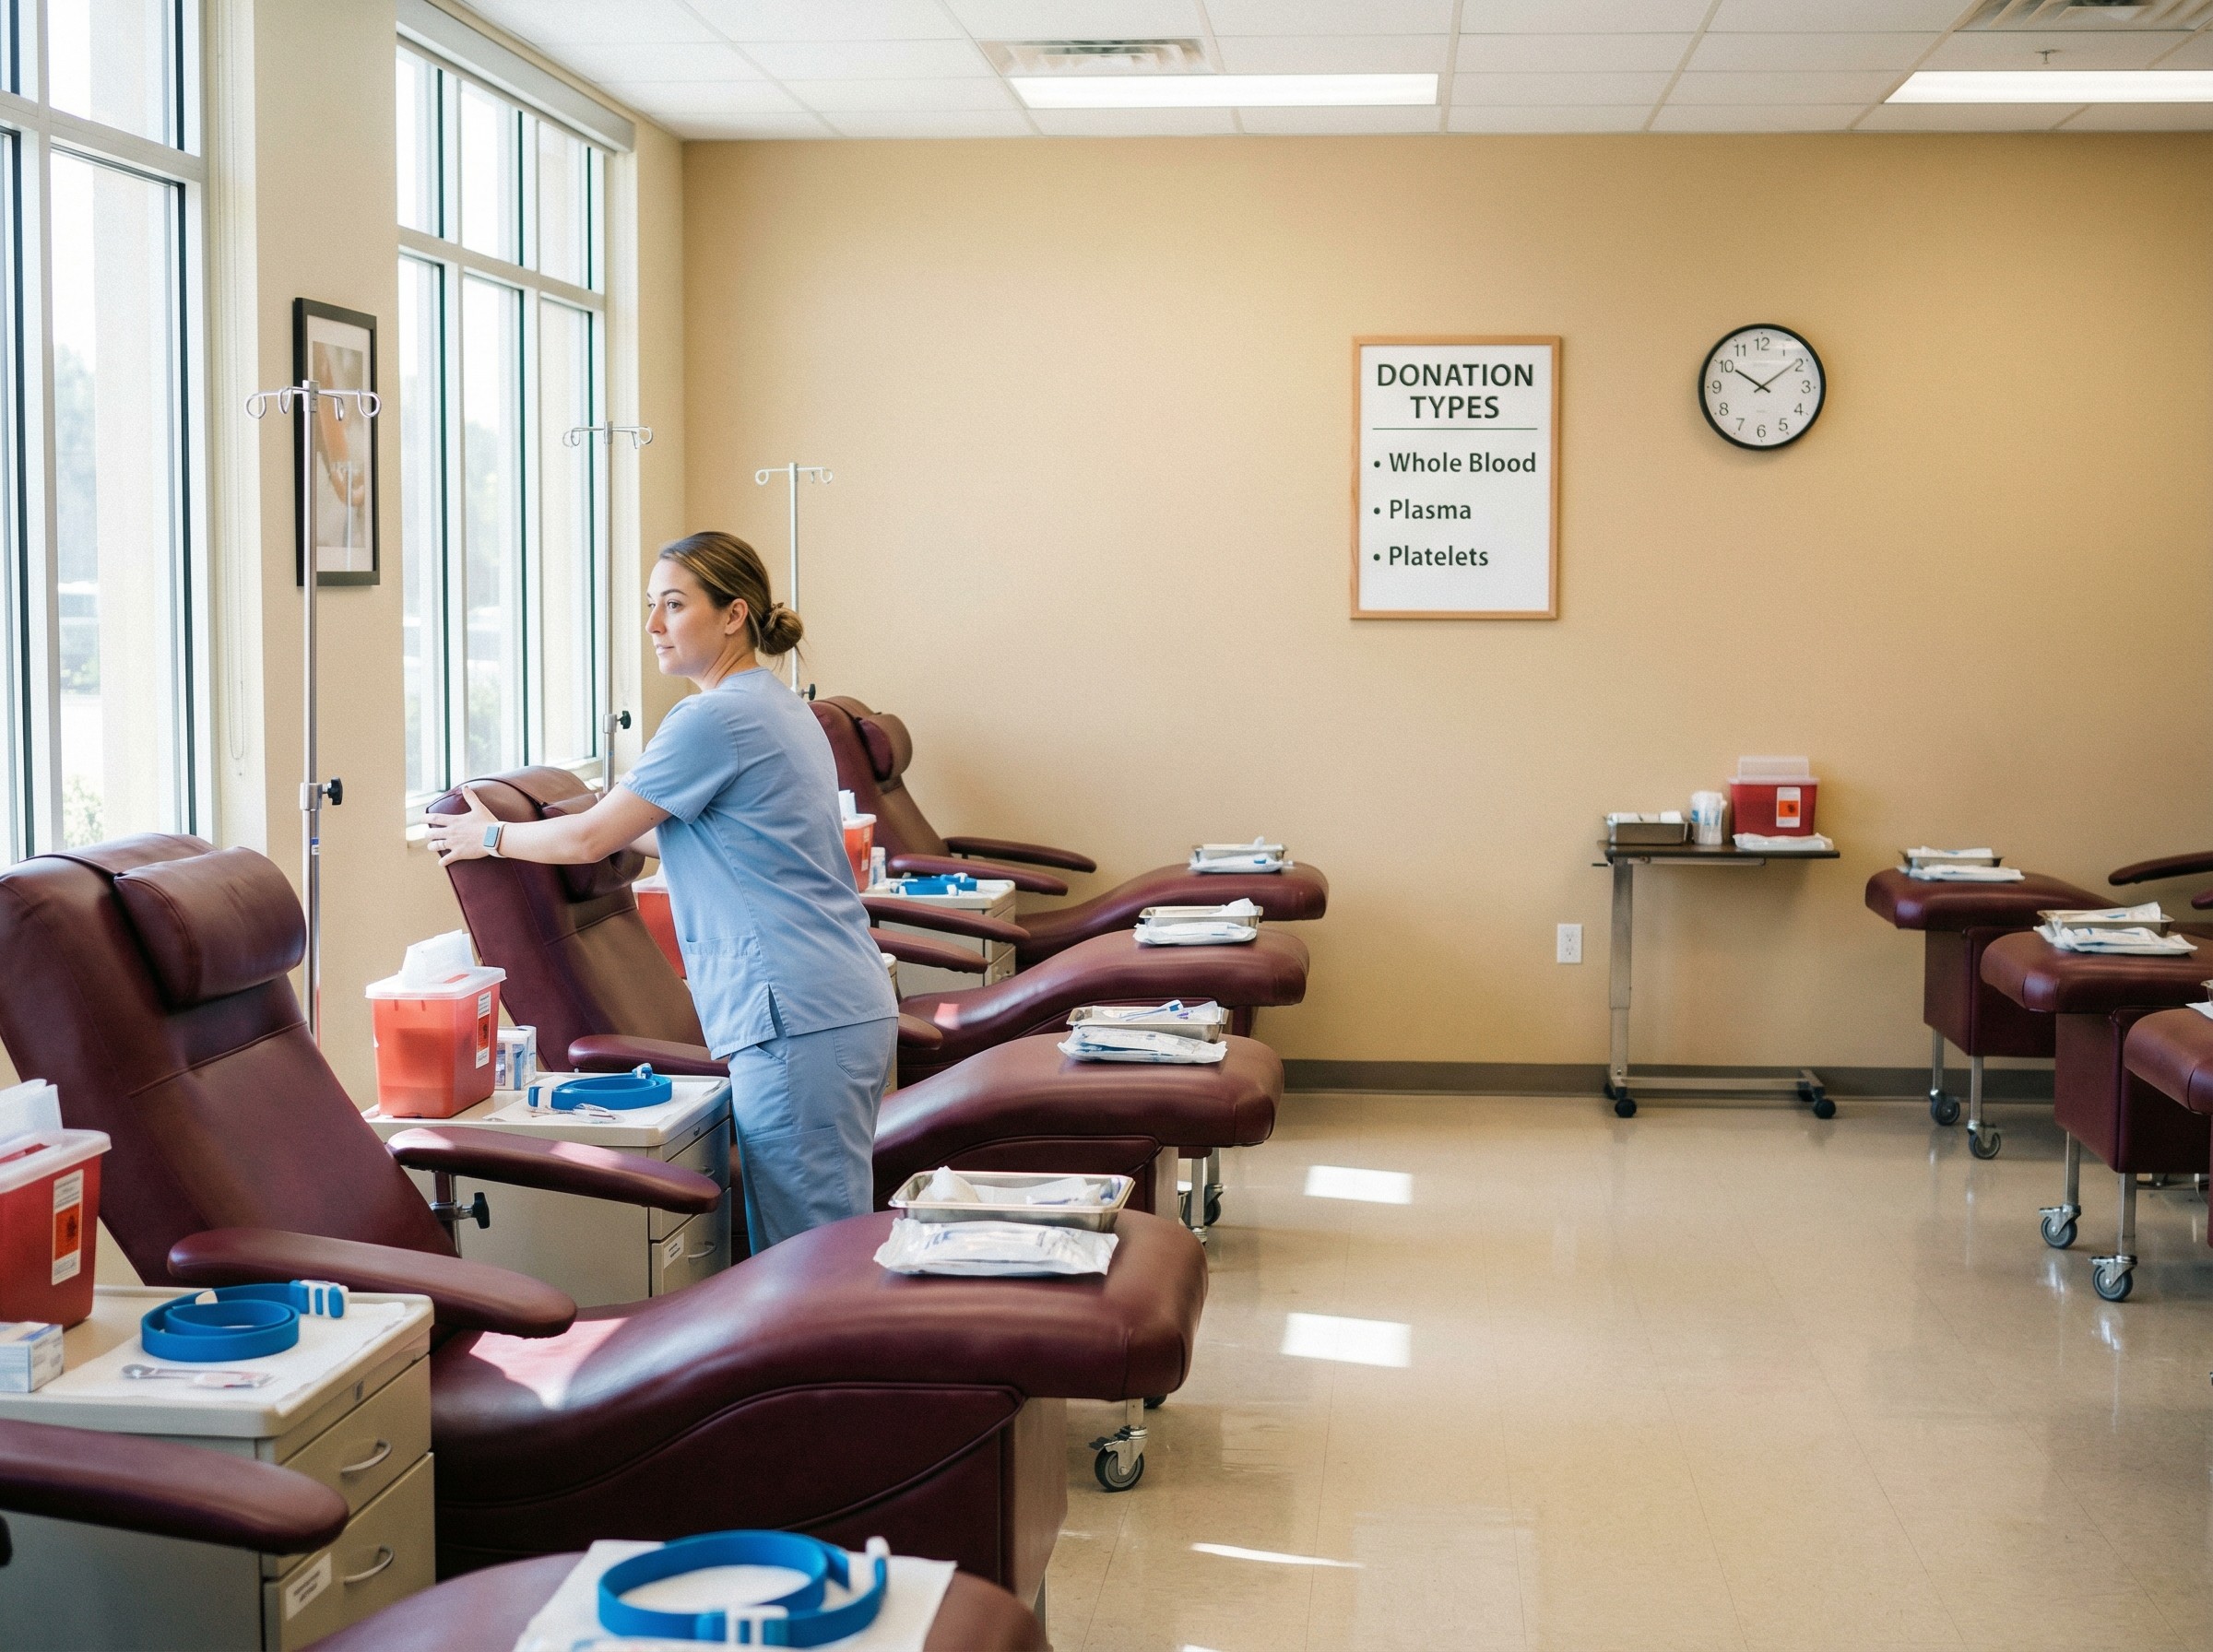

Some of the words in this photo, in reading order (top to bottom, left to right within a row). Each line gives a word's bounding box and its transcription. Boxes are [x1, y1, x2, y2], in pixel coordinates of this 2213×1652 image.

[1734, 344, 1746, 357] 11
[1754, 337, 1770, 351] 12
[1720, 360, 1734, 372] 10
[1794, 358, 1804, 372] 2
[1379, 364, 1533, 386] DONATION
[1711, 380, 1722, 394] 9
[1801, 380, 1811, 394] 3
[1410, 396, 1498, 419] TYPES
[1719, 402, 1729, 416] 8
[1793, 403, 1804, 416] 4
[1735, 418, 1746, 431] 7
[1757, 424, 1767, 438] 6
[1779, 418, 1788, 431] 5
[1390, 453, 1462, 472] Whole
[1470, 453, 1535, 472] Blood
[1391, 499, 1471, 519] Plasma
[1390, 546, 1488, 566] Platelets
